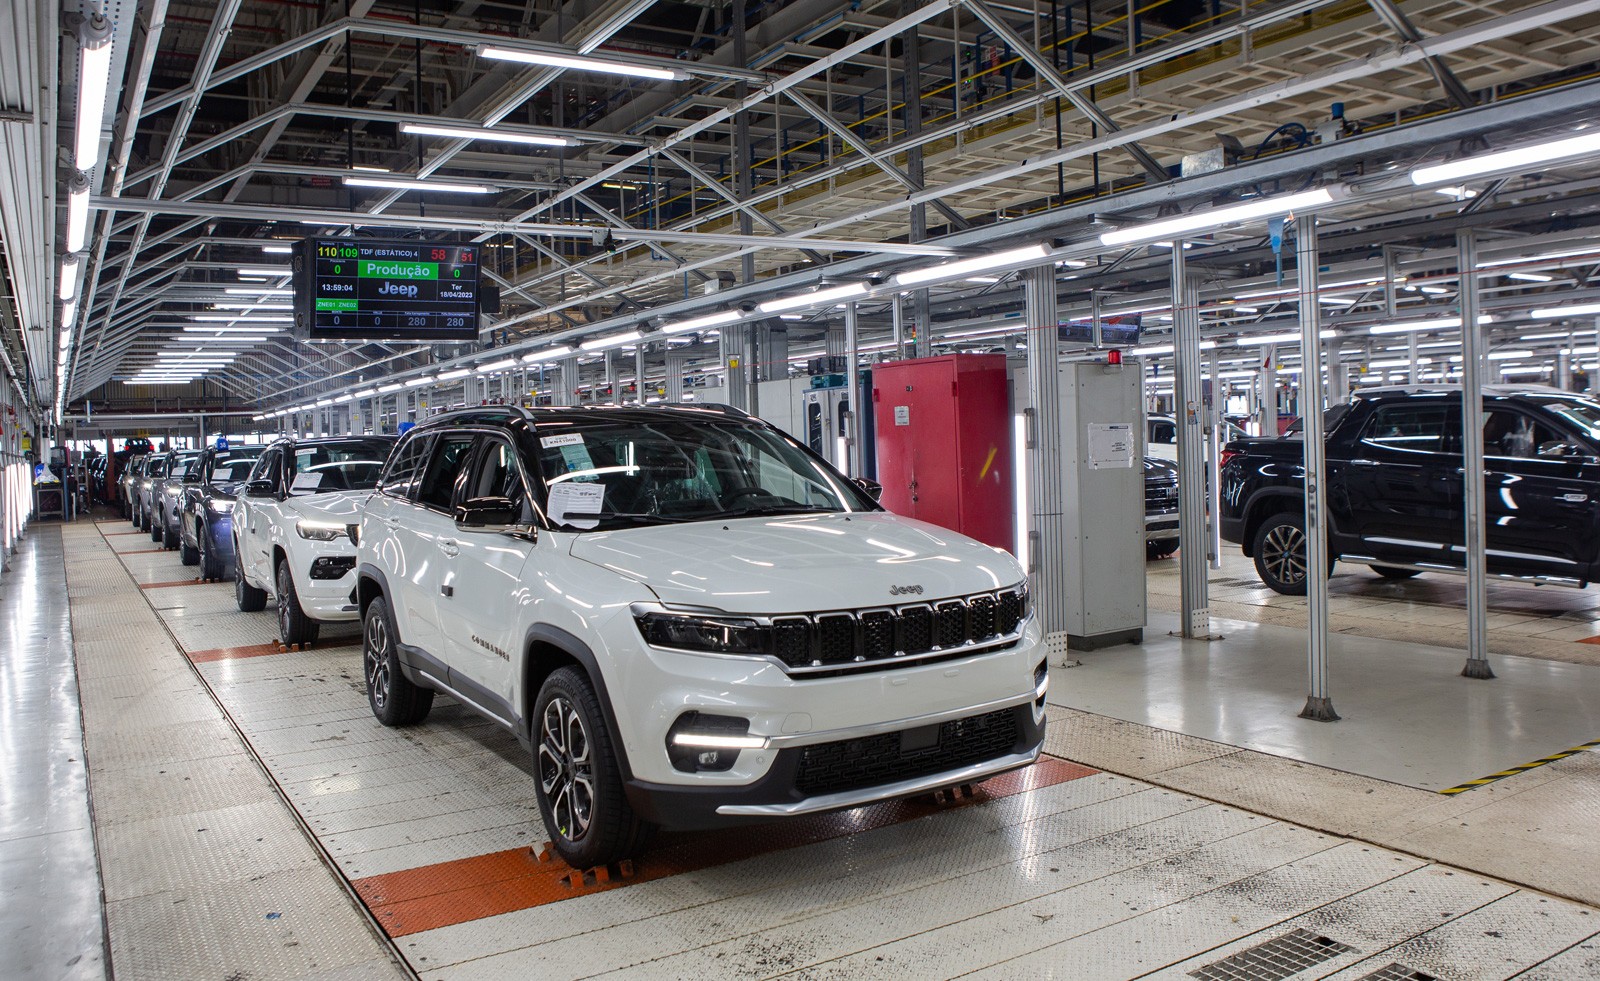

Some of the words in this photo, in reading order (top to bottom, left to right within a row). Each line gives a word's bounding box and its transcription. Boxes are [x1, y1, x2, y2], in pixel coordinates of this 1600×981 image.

[318, 247, 337, 257] 110
[339, 248, 358, 258] 109
[431, 249, 446, 260] 58
[461, 252, 472, 262] 51
[334, 264, 341, 274] 0
[367, 263, 430, 279] Produção
[454, 269, 460, 278] 0
[321, 283, 353, 292] 13:59:04
[378, 281, 418, 298] Jeep
[440, 291, 473, 299] 18/04/2023
[333, 315, 340, 325] 0
[374, 316, 381, 326] 0
[408, 317, 426, 326] 280
[446, 317, 464, 327] 280
[889, 584, 924, 596] Jeep
[471, 634, 510, 662] COMMANDER
